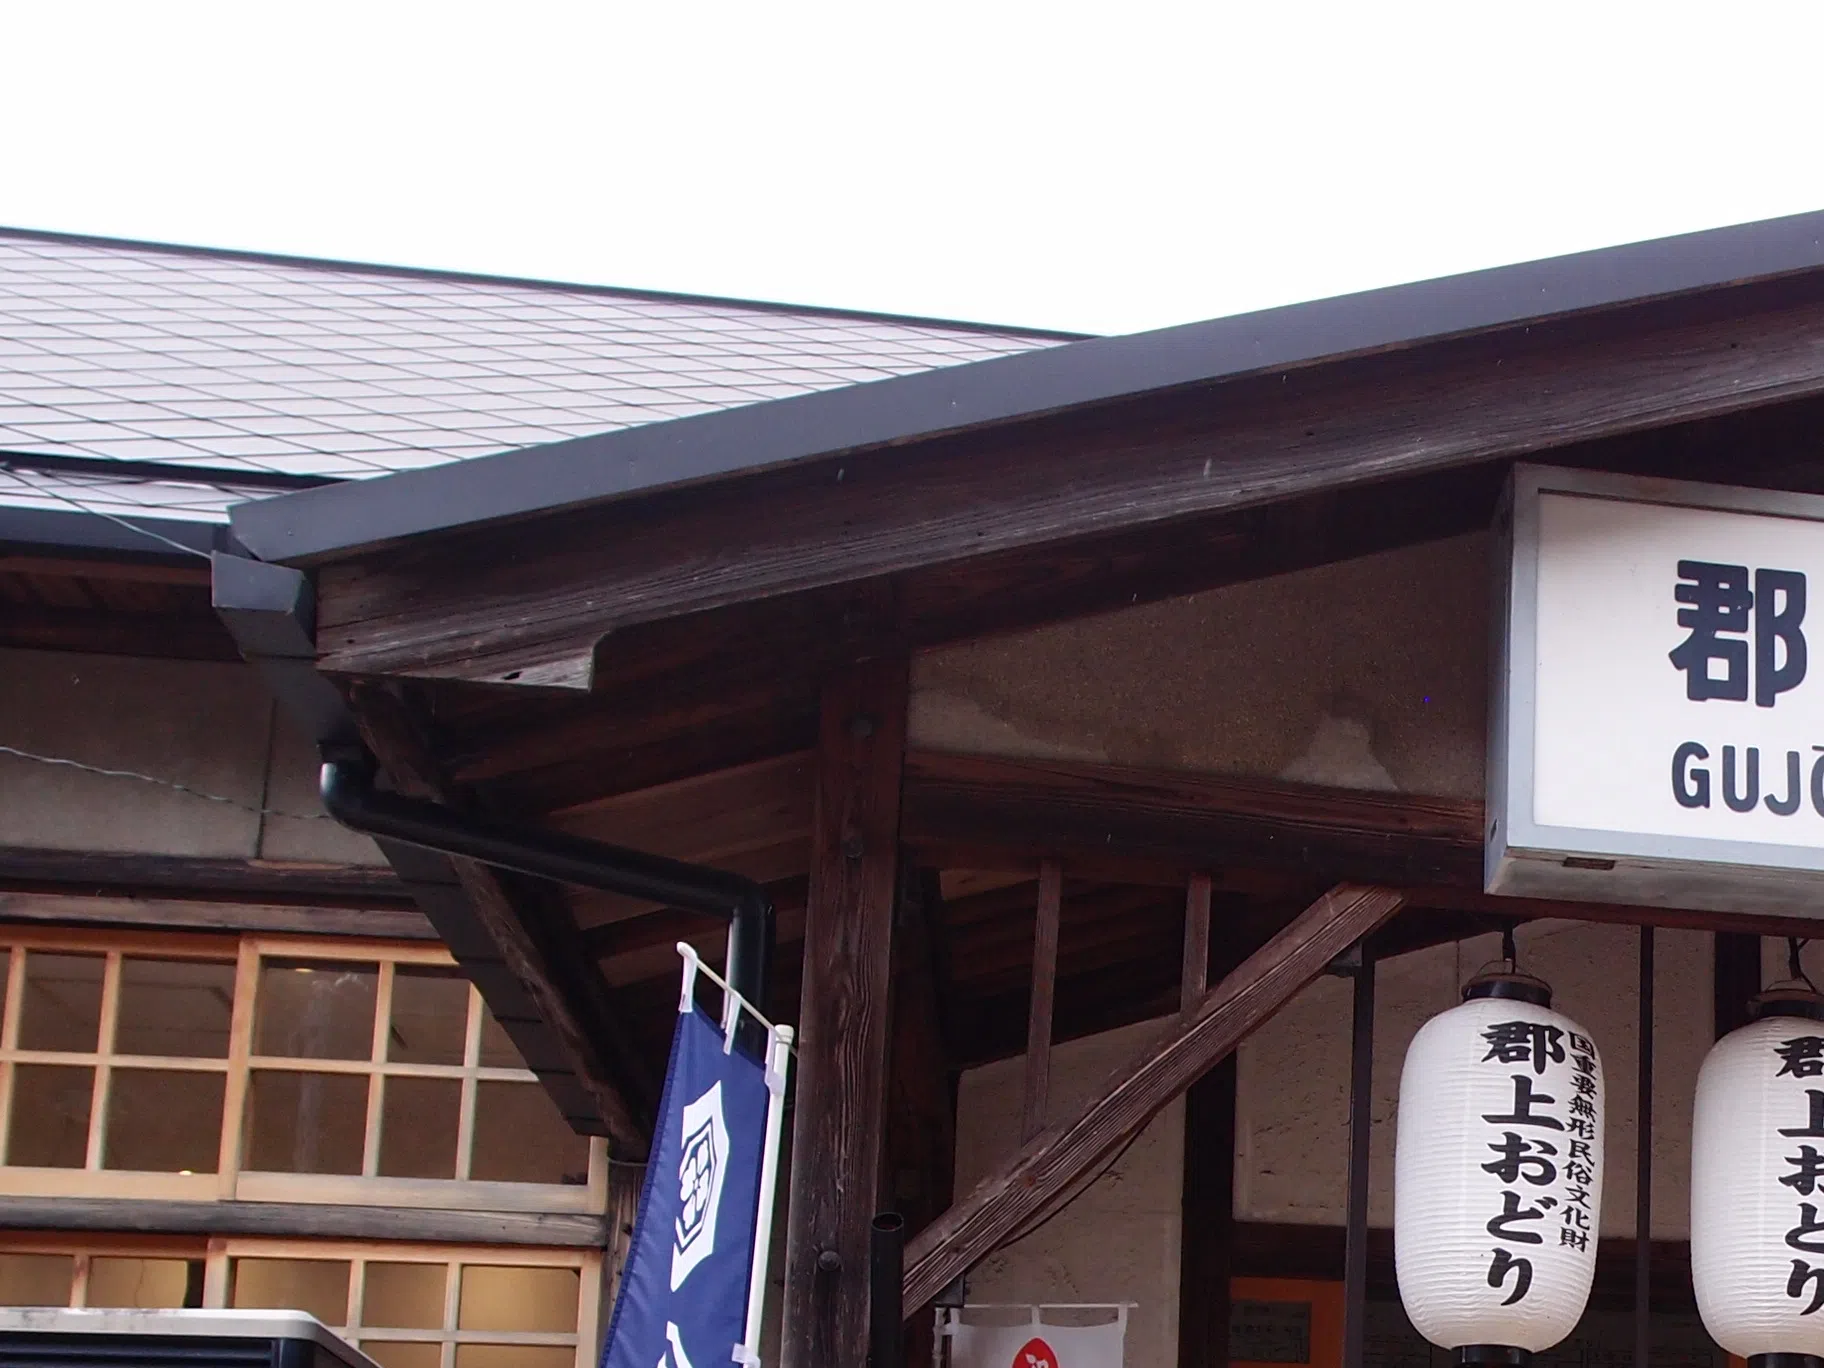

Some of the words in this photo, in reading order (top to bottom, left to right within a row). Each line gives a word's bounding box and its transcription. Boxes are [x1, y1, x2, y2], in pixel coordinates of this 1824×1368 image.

[1481, 1021, 1565, 1305] 郡上おどり
[1559, 1031, 1597, 1252] 国重要無形民俗文化財
